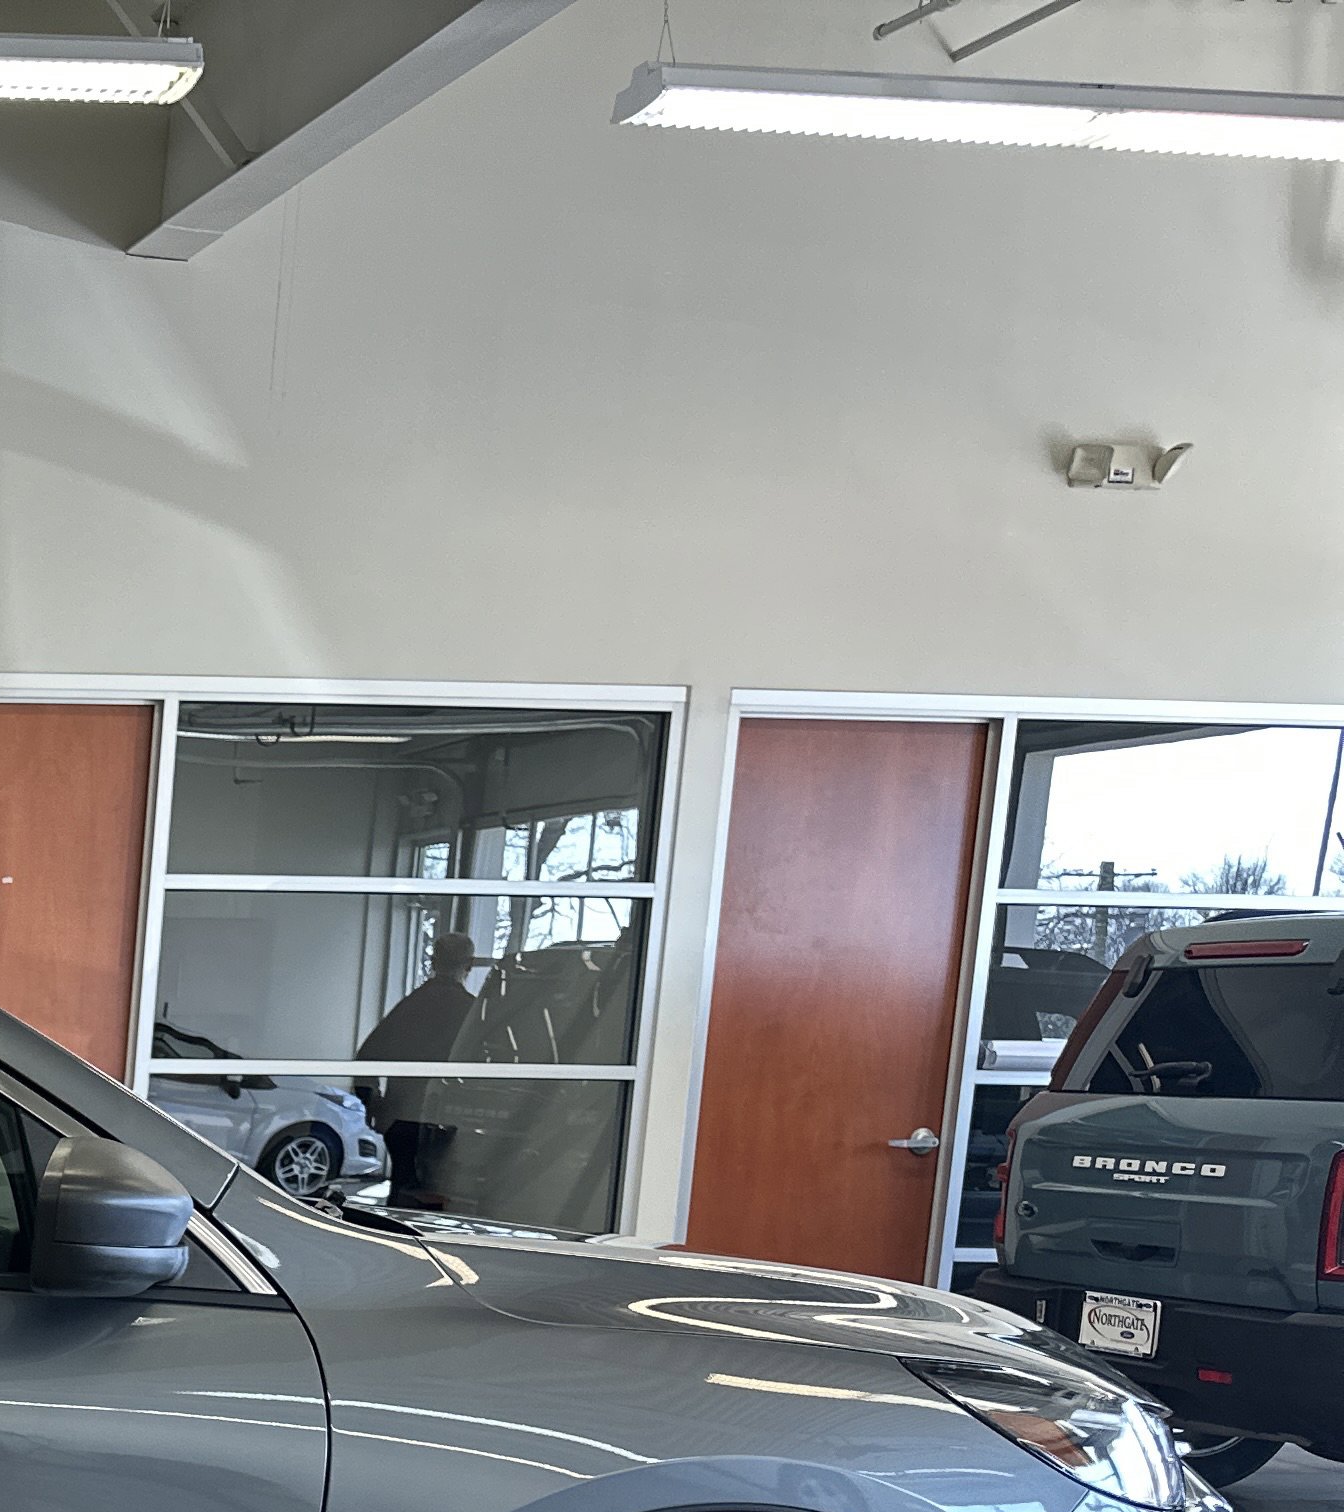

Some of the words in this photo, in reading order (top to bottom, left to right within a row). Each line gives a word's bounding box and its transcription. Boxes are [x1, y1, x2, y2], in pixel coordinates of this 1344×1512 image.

[1072, 1155, 1227, 1178] BRONCO
[1113, 1173, 1170, 1184] SPORT
[1092, 1308, 1145, 1332] NORTHGATE
